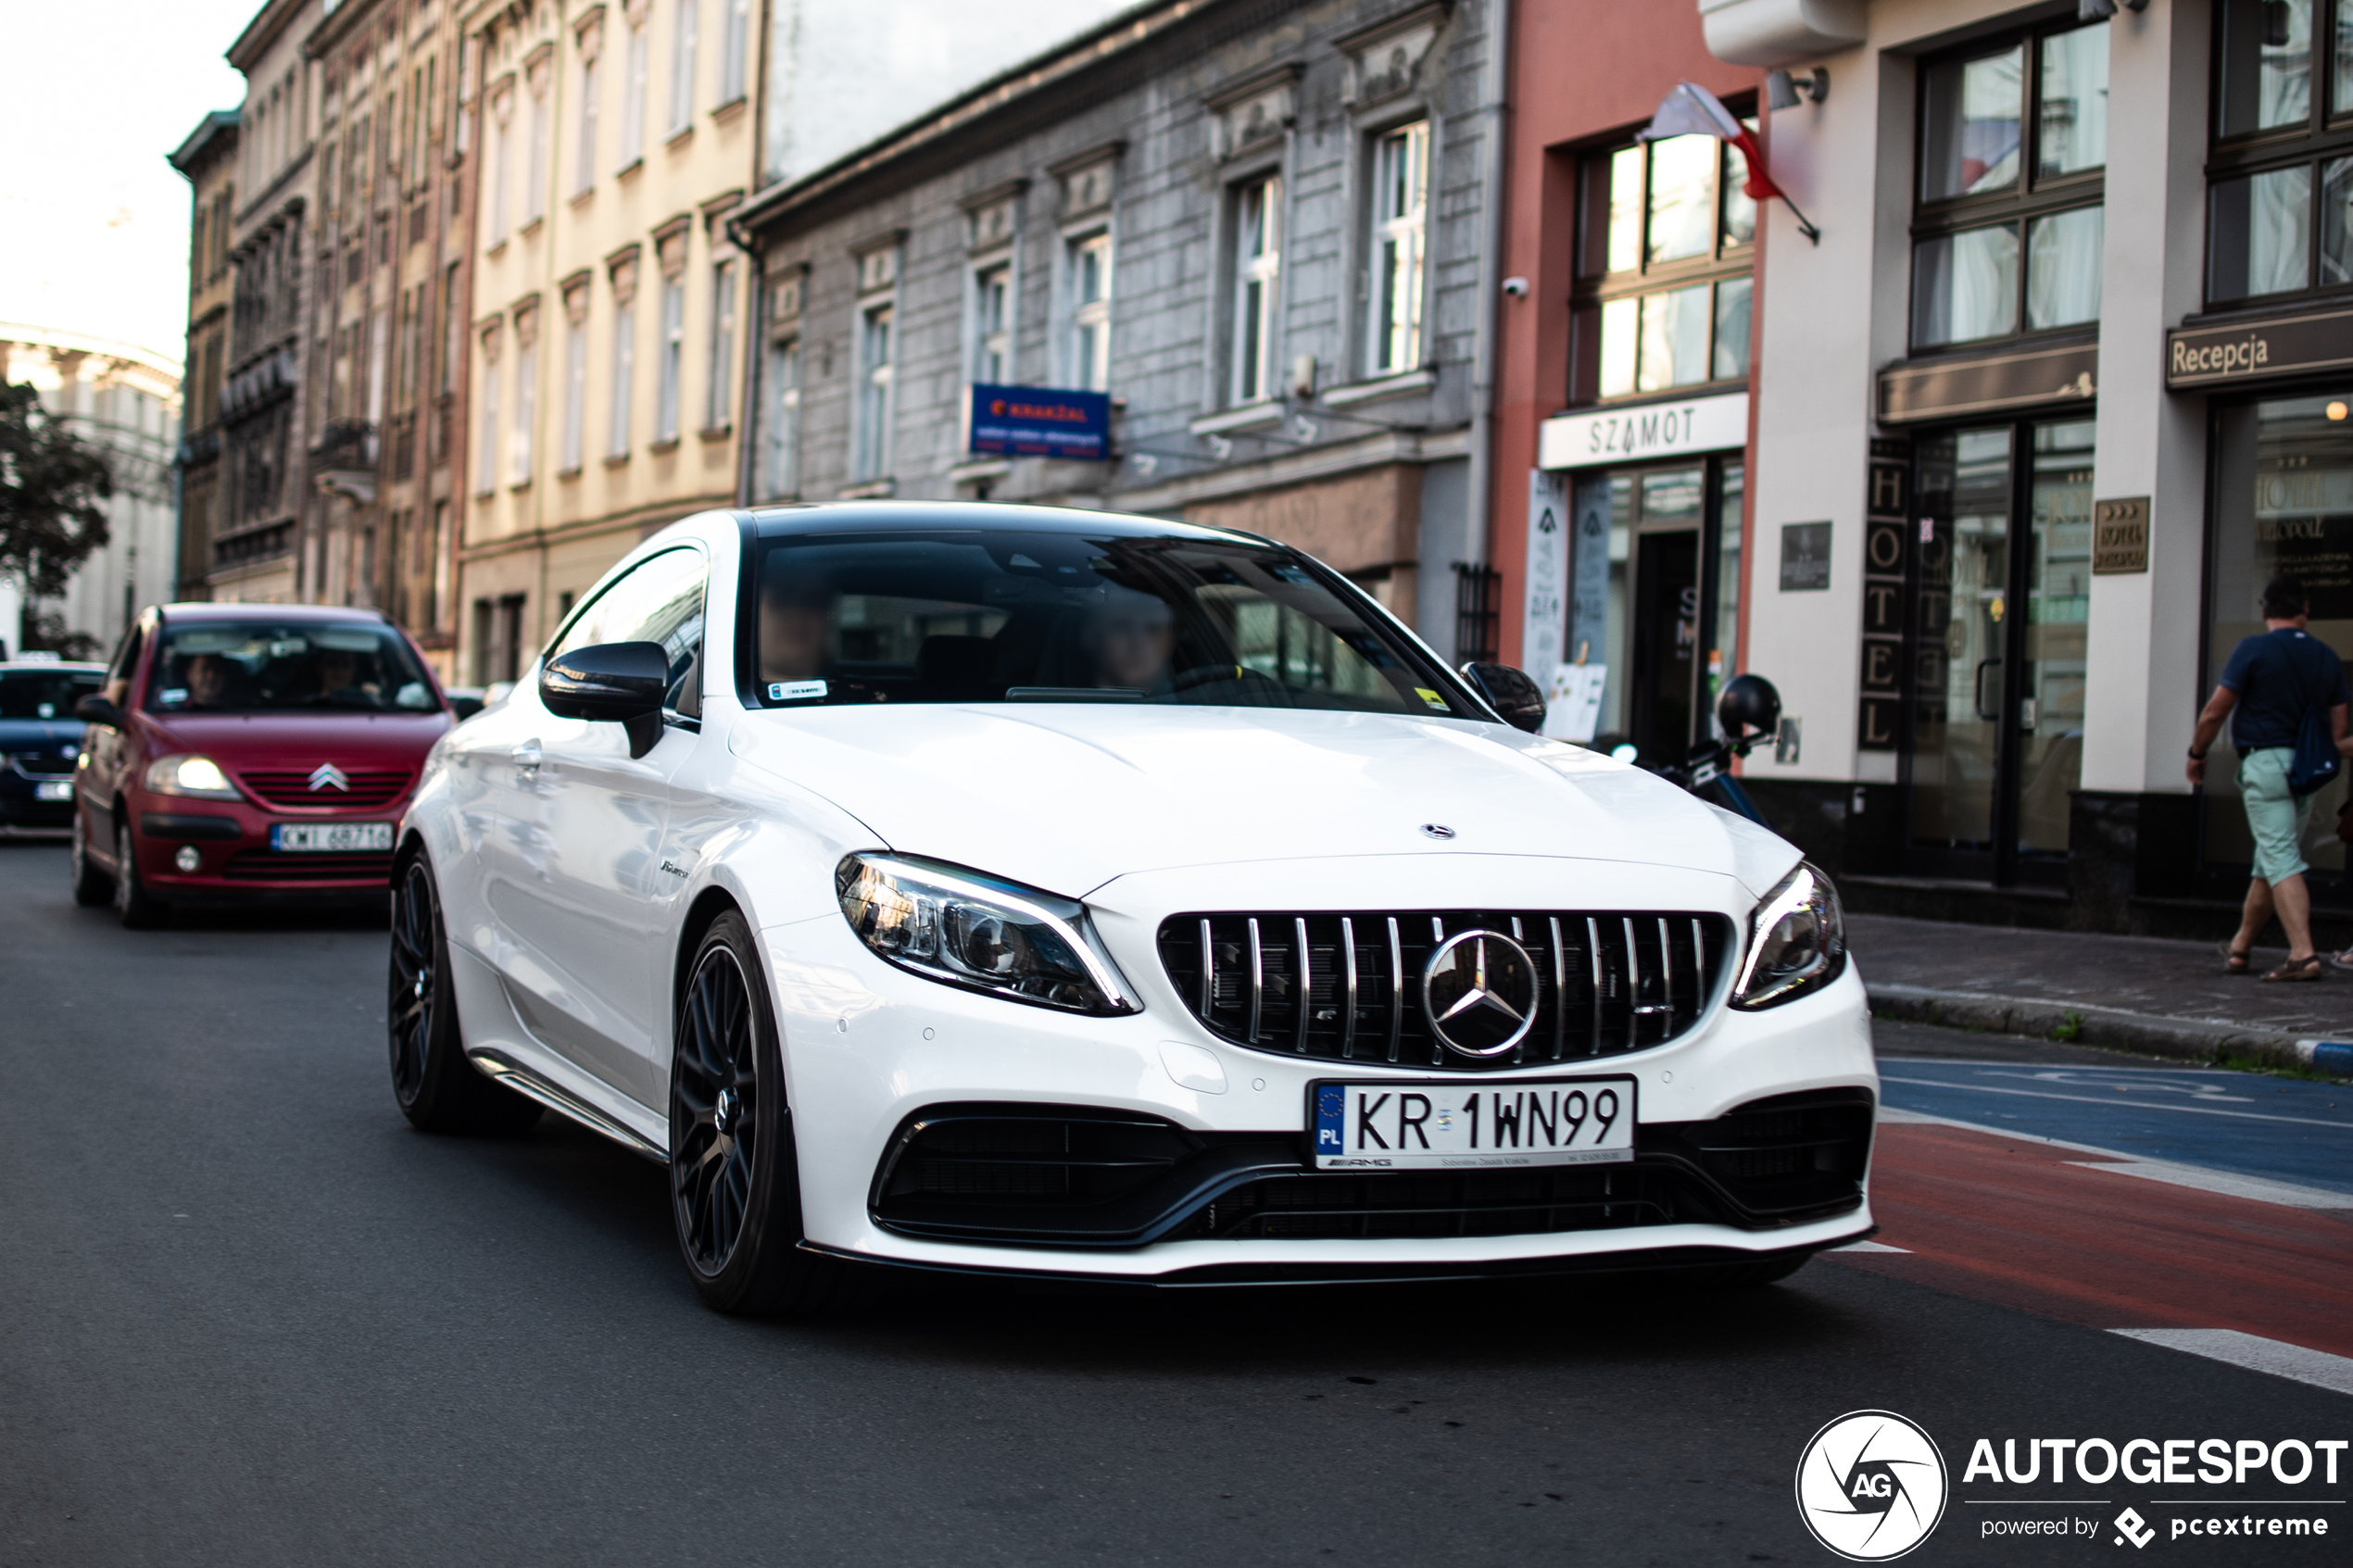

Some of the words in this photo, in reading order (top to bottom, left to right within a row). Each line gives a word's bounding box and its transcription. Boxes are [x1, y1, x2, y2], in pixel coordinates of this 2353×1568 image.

[2172, 333, 2268, 376] Recepcja
[1866, 469, 1902, 743] HOTEL
[1319, 1129, 1341, 1146] PL
[1357, 1092, 1431, 1150] KR
[1462, 1088, 1618, 1148] 1WN99
[1348, 1158, 1392, 1167] AMG
